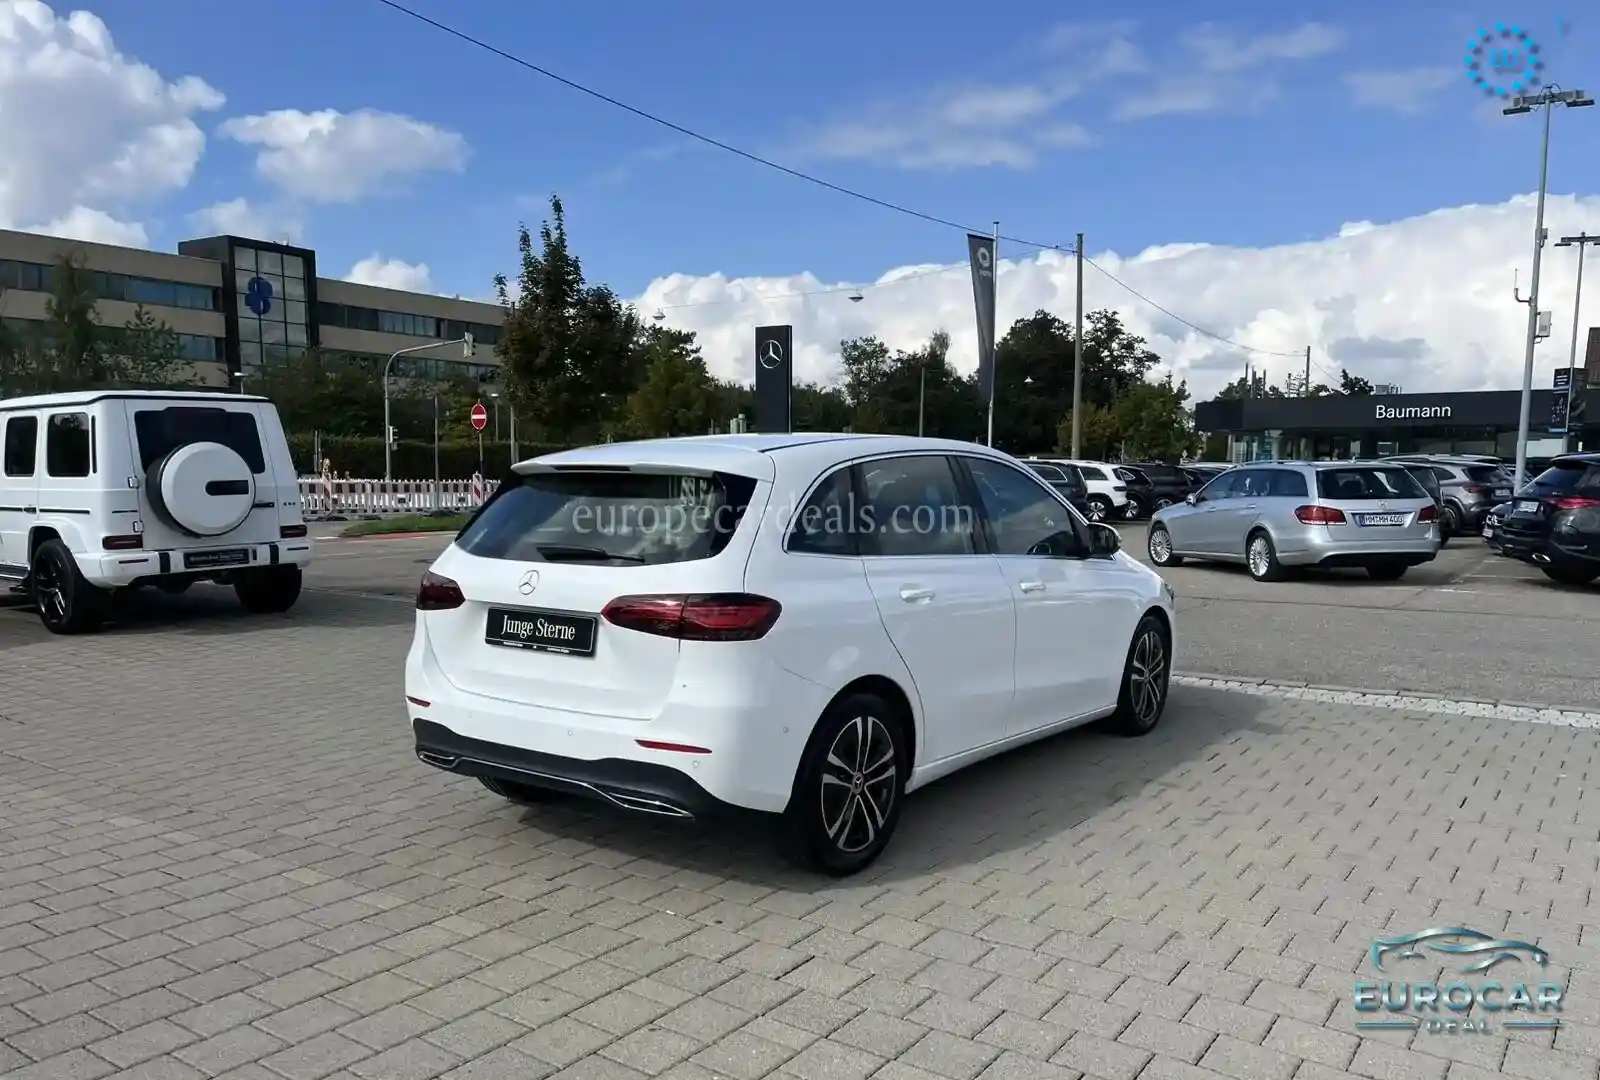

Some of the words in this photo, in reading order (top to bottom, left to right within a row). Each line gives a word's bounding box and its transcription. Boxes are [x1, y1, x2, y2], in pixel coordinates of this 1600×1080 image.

[1376, 404, 1451, 419] Baumann
[501, 614, 533, 639] Junge
[535, 618, 576, 641] Sterne
